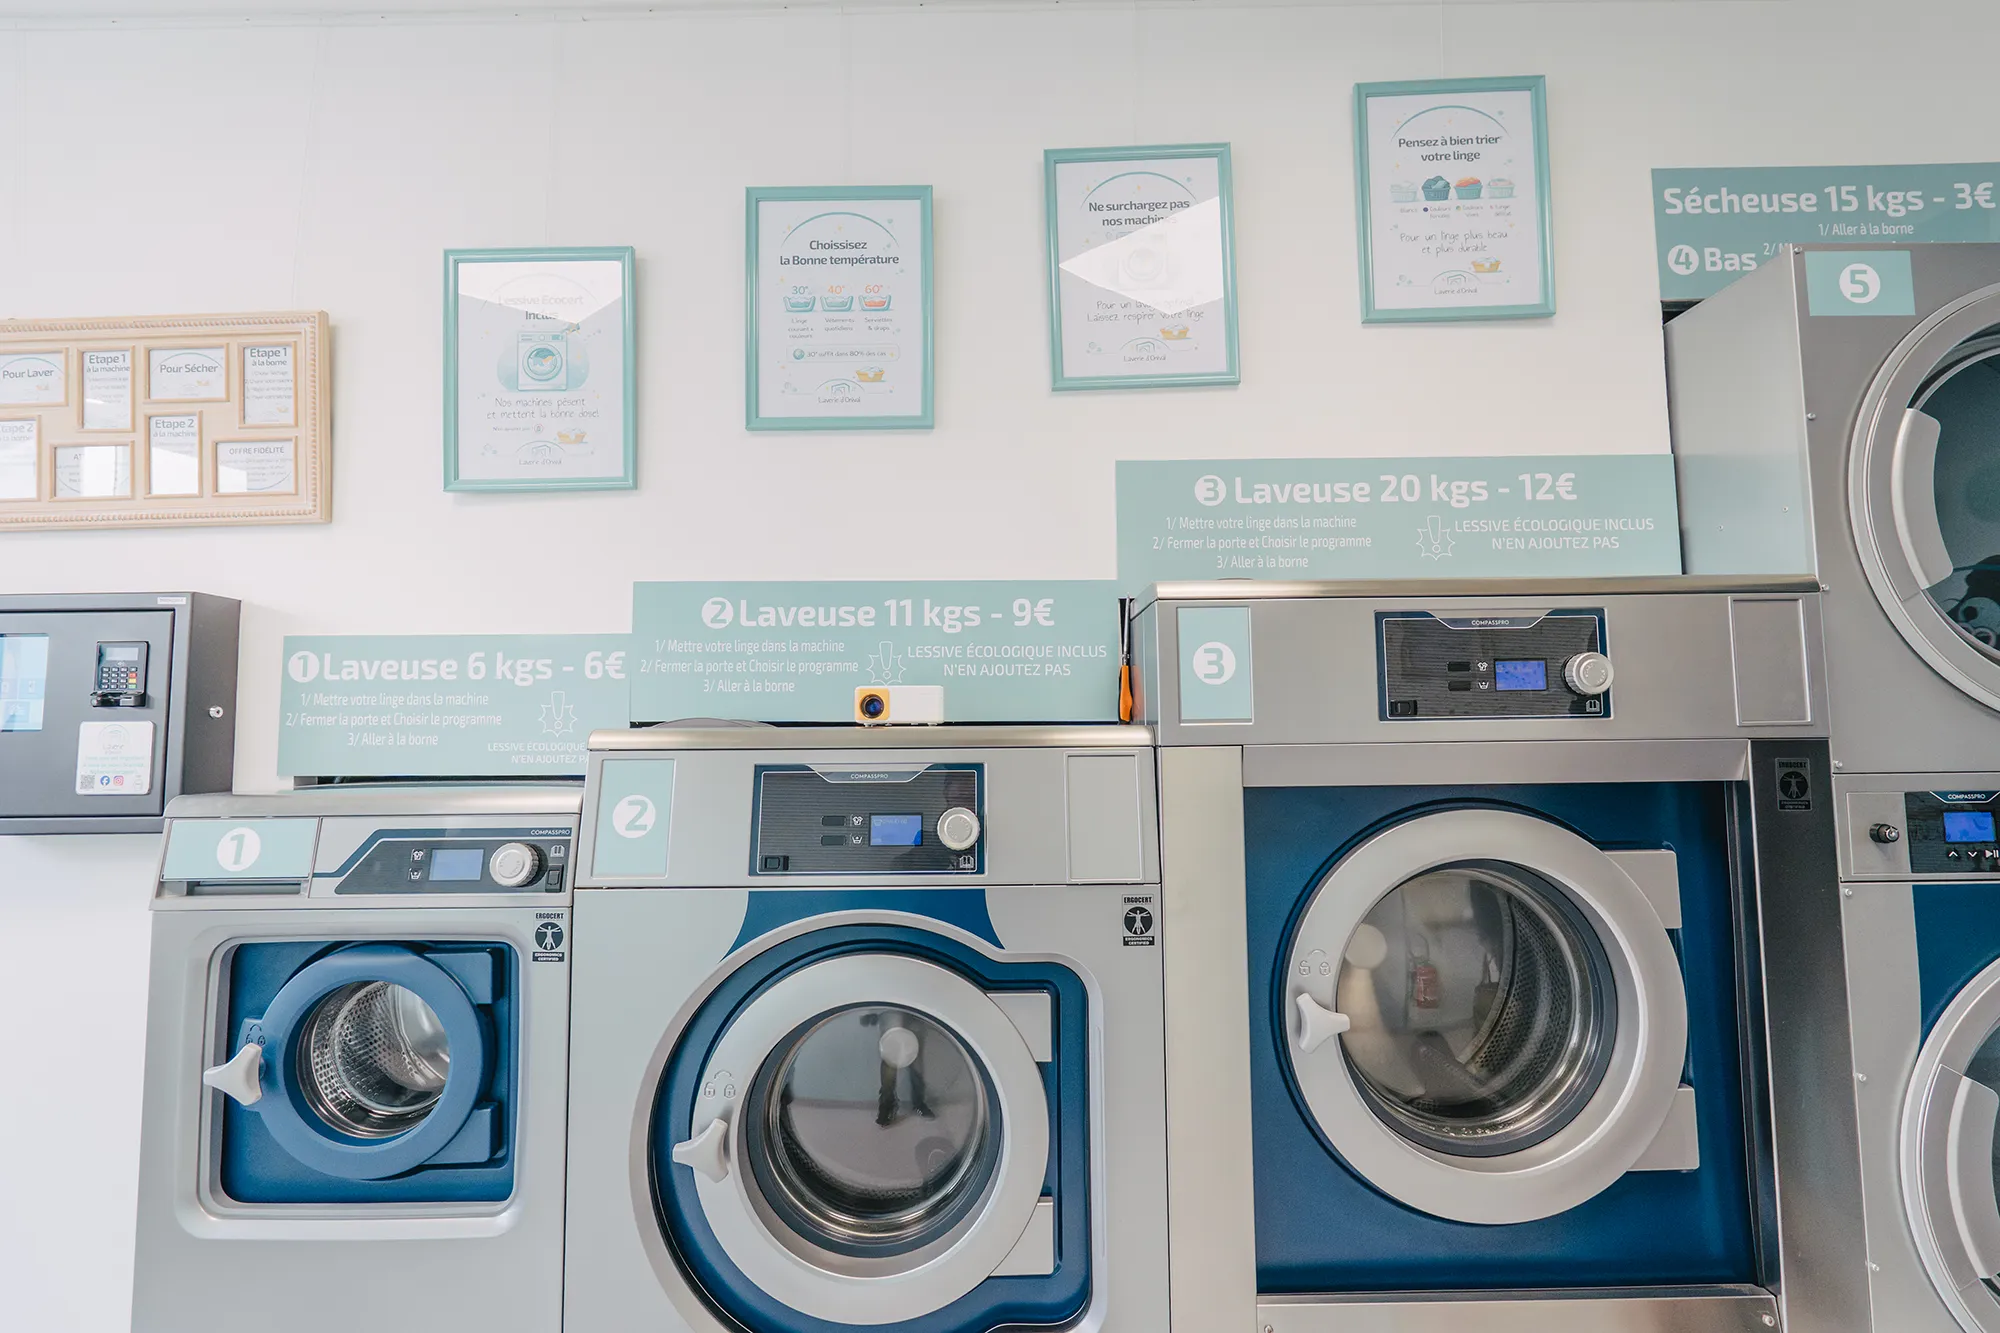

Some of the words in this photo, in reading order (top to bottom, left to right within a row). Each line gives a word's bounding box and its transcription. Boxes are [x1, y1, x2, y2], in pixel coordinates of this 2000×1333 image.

[1399, 138, 1438, 148] Pensez
[1441, 137, 1448, 146] à
[1450, 136, 1473, 146] bien
[1475, 135, 1499, 145] trier
[1421, 153, 1451, 161] votre
[1453, 151, 1480, 162] linge
[1089, 202, 1104, 212] Ne
[1106, 201, 1168, 212] surchargez
[1170, 200, 1189, 210] pas
[1664, 187, 1817, 215] Sécheuse
[1824, 185, 1858, 212] 15
[1866, 185, 1924, 217] kgs
[1954, 182, 1996, 210] 3€
[1102, 217, 1122, 226] nos
[1819, 224, 1830, 236] 1/
[1832, 224, 1857, 235] Aller
[1860, 223, 1866, 234] à
[1869, 224, 1879, 234] la
[1882, 223, 1914, 234] borne
[1400, 233, 1419, 242] Pour
[1441, 231, 1459, 244] linge
[1464, 231, 1483, 242] plus
[1487, 230, 1508, 239] beau
[810, 240, 867, 250] Choissisez
[1435, 244, 1453, 256] plus
[1458, 243, 1487, 252] durable
[780, 256, 791, 265] la
[793, 256, 827, 265] Bonne
[830, 255, 899, 266] température
[1705, 247, 1757, 271] Bas
[792, 286, 808, 295] 30°
[828, 285, 845, 294] 40°
[865, 285, 883, 294] 60°
[1848, 268, 1872, 300] 5
[1097, 300, 1115, 310] Pour
[1087, 313, 1120, 322] Laissez
[1123, 312, 1155, 324] respirer
[1160, 310, 1182, 319] votre
[1186, 309, 1204, 322] linge
[89, 355, 117, 364] Etape
[120, 355, 125, 363] 1
[250, 348, 280, 358] Etape
[283, 348, 287, 356] 1
[3, 370, 25, 378] Pour
[28, 368, 54, 377] Laver
[160, 364, 182, 373] Pour
[185, 363, 218, 373] Sécher
[495, 398, 512, 407] Nos
[516, 398, 552, 406] machines
[501, 409, 535, 418] mettent
[541, 409, 546, 417] la
[551, 409, 574, 417] bonne
[579, 409, 599, 417] dose!
[155, 419, 185, 429] Etape
[188, 419, 194, 428] 2
[253, 445, 284, 454] FIDÉLITÉ
[1235, 477, 1371, 504] Laveuse
[1380, 475, 1421, 502] 20
[1431, 475, 1488, 508] kgs
[1518, 473, 1577, 501] 12€
[1166, 517, 1176, 530] 1/
[1180, 517, 1214, 529] Mettre
[1216, 518, 1243, 528] votre
[1246, 516, 1271, 531] linge
[1274, 516, 1298, 527] dans
[1301, 516, 1310, 527] la
[1313, 514, 1356, 527] machine
[1456, 520, 1510, 532] LESSIVE
[1514, 517, 1602, 533] ÉCOLOGIQUE
[1605, 518, 1654, 530] INCLUS
[1153, 537, 1165, 550] 2/
[1167, 537, 1204, 549] Fermer
[1207, 537, 1216, 548] la
[1219, 537, 1246, 551] porte
[1249, 537, 1259, 548] et
[1261, 536, 1297, 548] Choisir
[1300, 536, 1308, 547] le
[1311, 536, 1371, 550] programme
[1493, 537, 1525, 549] N'EN
[1528, 537, 1589, 549] AJOUTEZ
[1593, 536, 1619, 548] PAS
[1217, 556, 1228, 568] 3/
[1231, 556, 1255, 567] Aller
[1257, 555, 1264, 567] à
[1266, 555, 1275, 567] la
[1279, 555, 1308, 567] borne
[741, 599, 875, 627] Laveuse
[884, 599, 911, 626] 11
[924, 599, 981, 633] kgs
[1013, 598, 1055, 626] 9€
[908, 645, 962, 657] LESSIVE
[967, 642, 1052, 659] ÉCOLOGIQUE
[1057, 645, 1106, 657] INCLUS
[324, 653, 458, 680] Laveuse
[467, 653, 486, 679] 6
[496, 651, 552, 686] kgs
[584, 651, 626, 679] 6€
[641, 660, 653, 672] 2/
[655, 660, 692, 672] Fermer
[694, 660, 703, 672] la
[706, 660, 733, 673] porte
[736, 661, 747, 672] et
[749, 659, 784, 672] Choisir
[787, 659, 796, 671] le
[799, 660, 858, 673] programme
[944, 664, 976, 676] N'EN
[980, 664, 1040, 676] AJOUTEZ
[1045, 664, 1071, 675] PAS
[1201, 646, 1227, 681] 3
[488, 743, 526, 751] LESSIVE
[527, 741, 585, 753] ÉCOLOGIQUE
[512, 754, 534, 764] N'EN
[535, 754, 579, 764] AJOUTEZ
[622, 796, 652, 835] 2
[226, 831, 249, 868] 1
